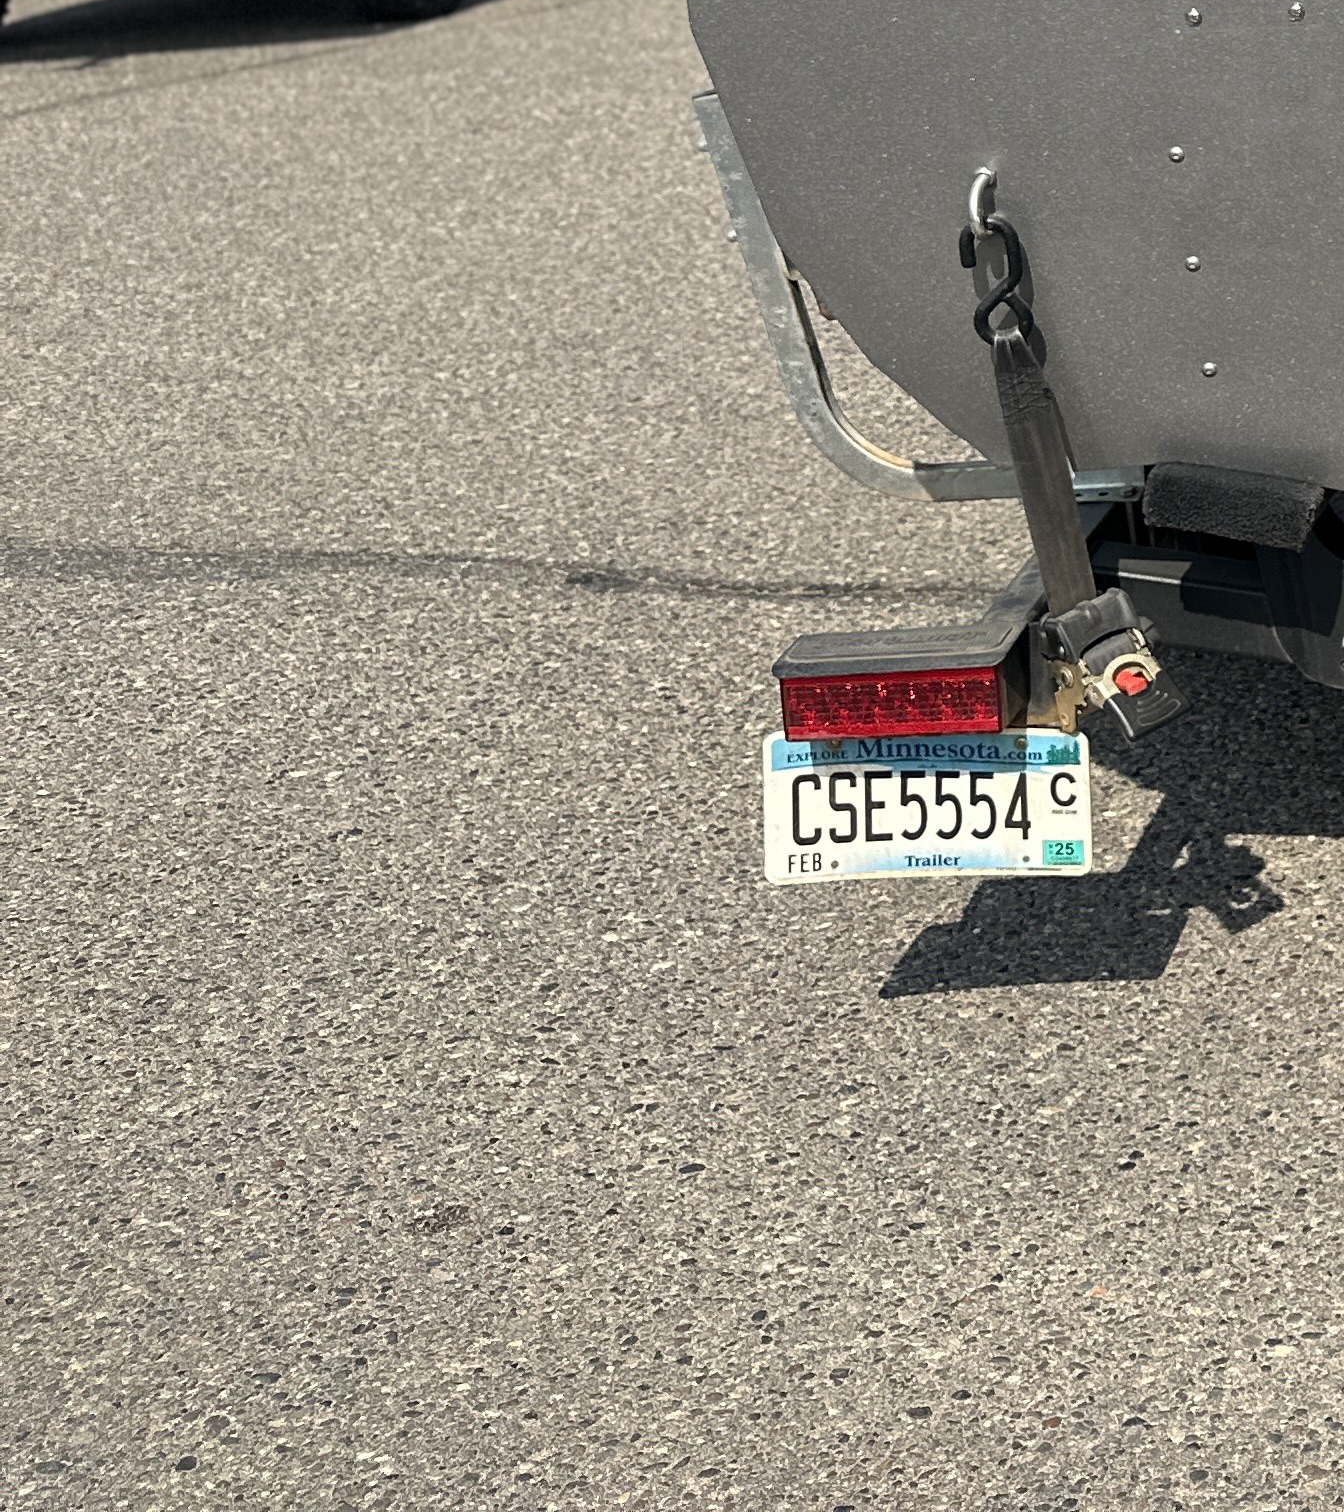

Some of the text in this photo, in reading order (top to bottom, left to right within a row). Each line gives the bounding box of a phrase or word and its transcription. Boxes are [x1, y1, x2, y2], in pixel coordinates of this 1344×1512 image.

[787, 738, 1043, 764] EXPLORE Minnesota.com
[792, 771, 1077, 846] CSE5554 C
[1054, 842, 1075, 856] 25
[788, 852, 822, 874] FEB
[905, 854, 961, 868] Trailer
